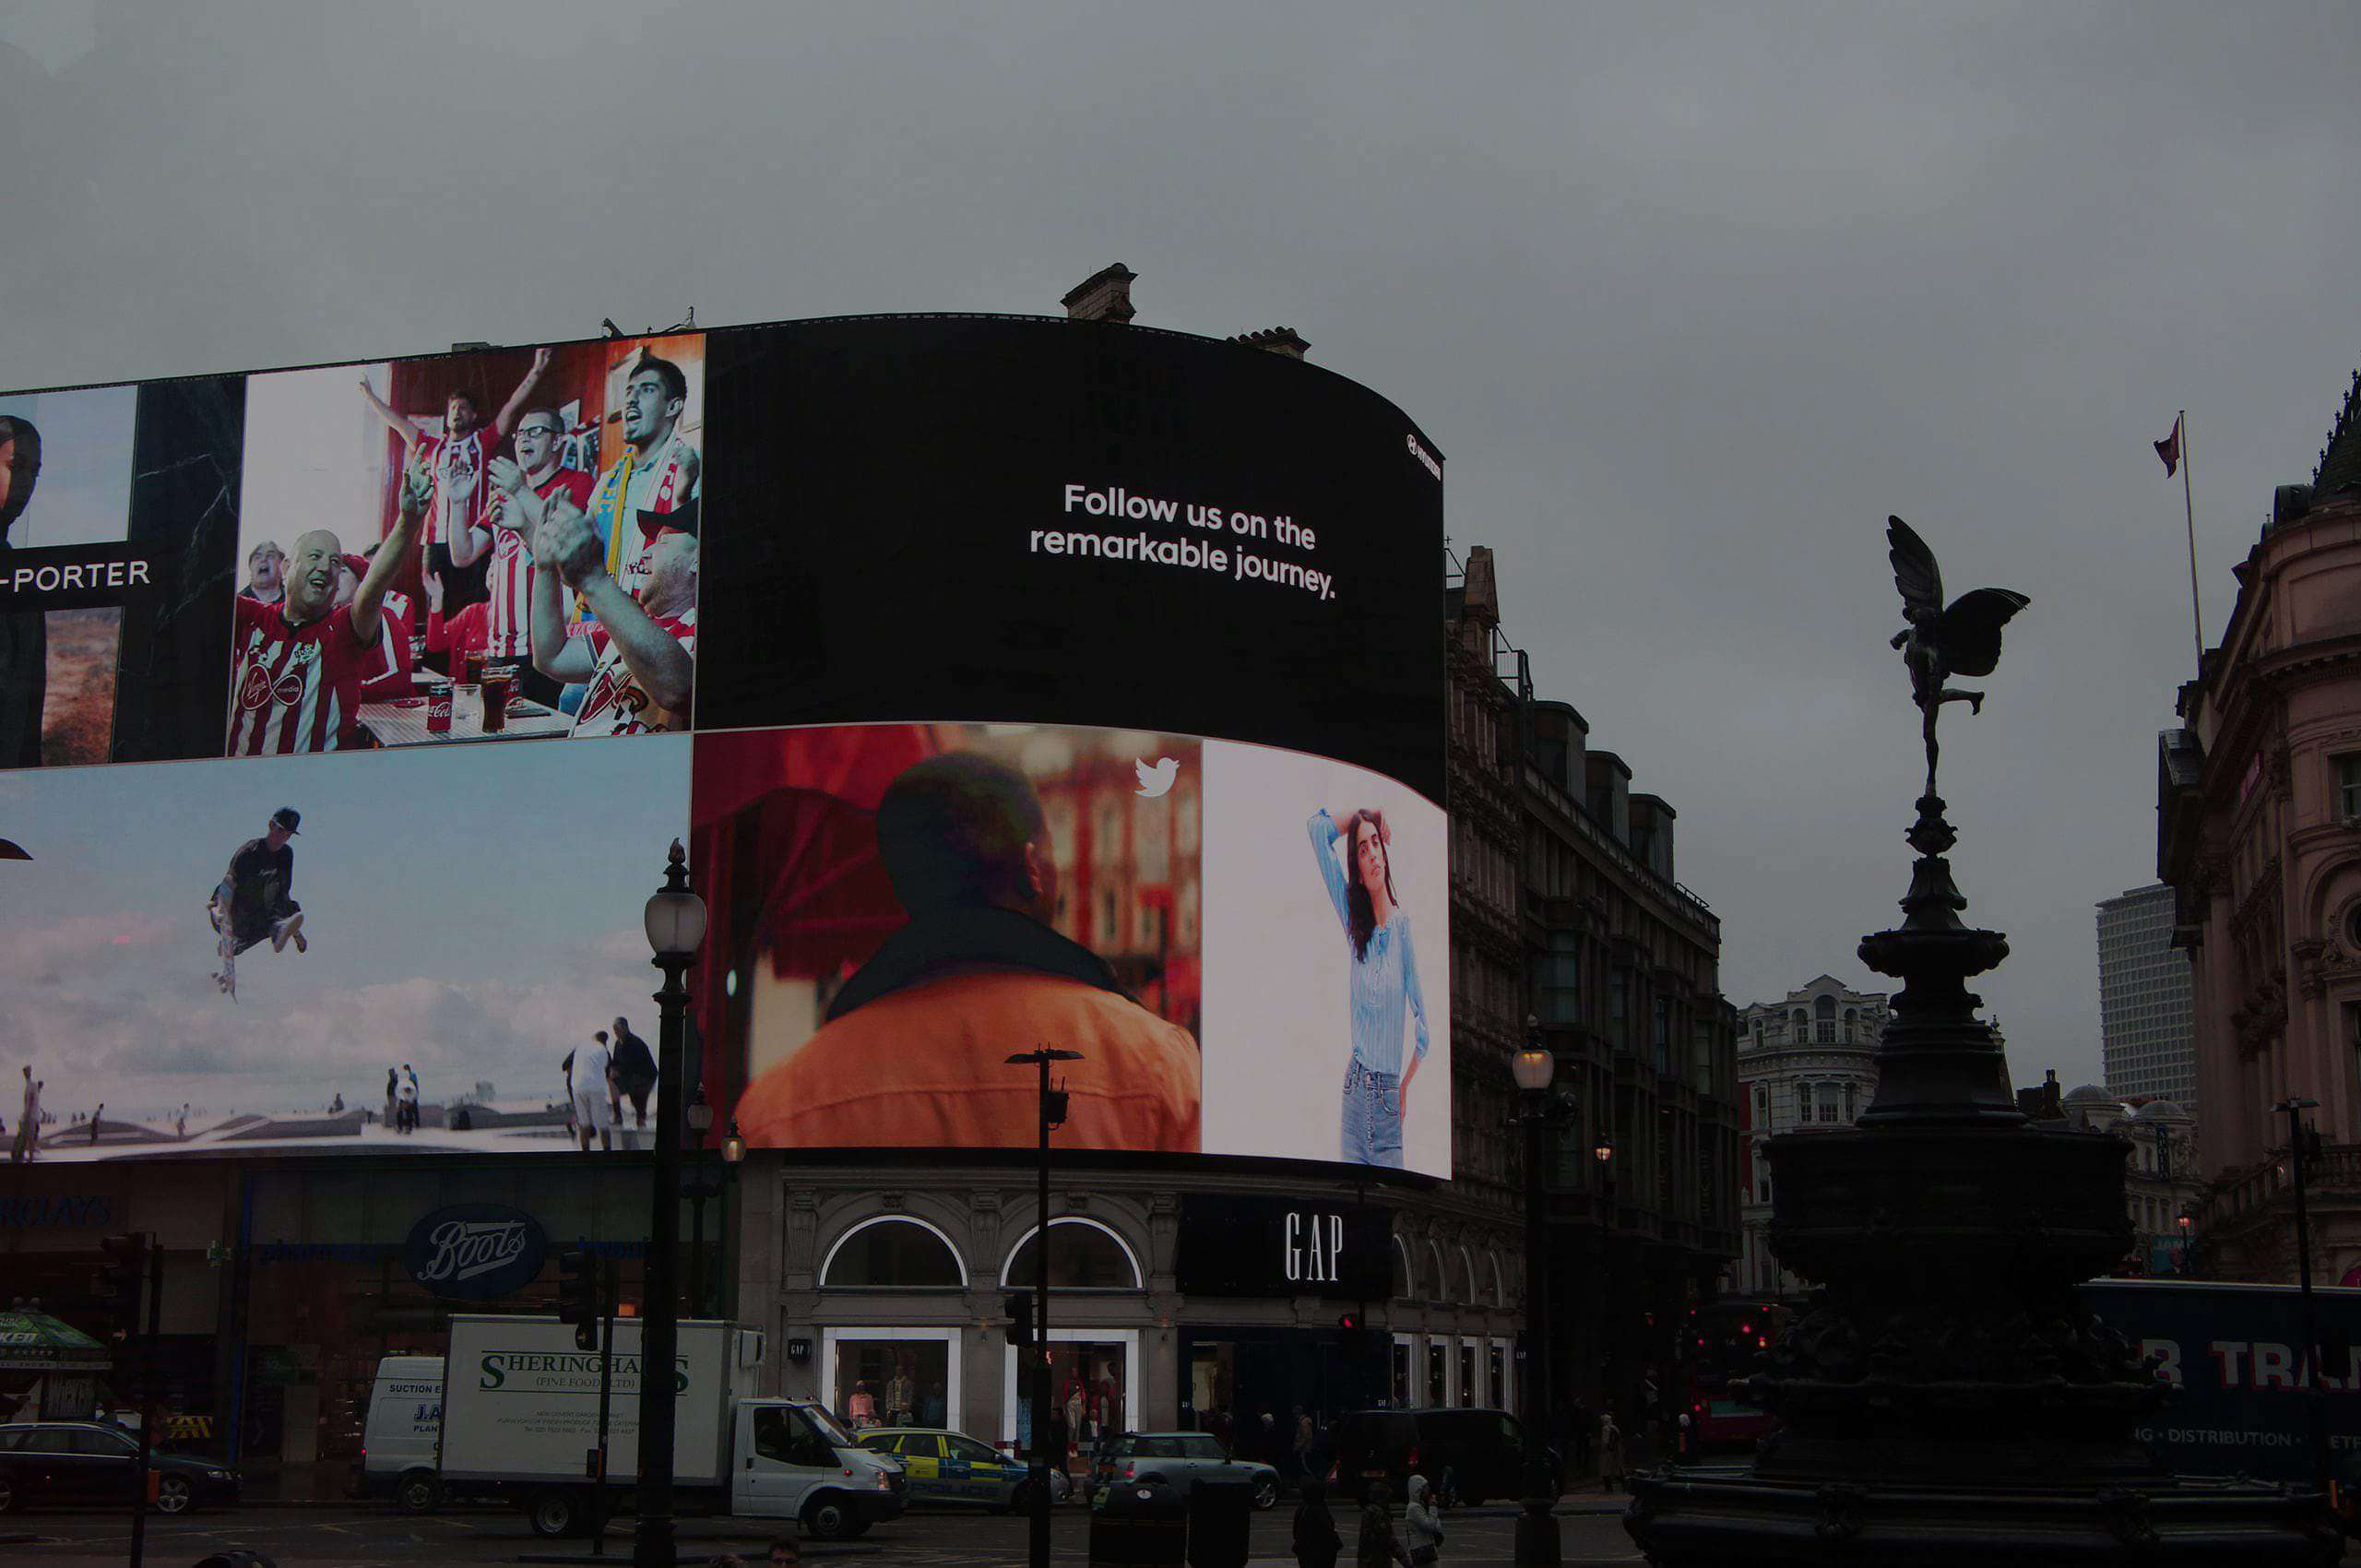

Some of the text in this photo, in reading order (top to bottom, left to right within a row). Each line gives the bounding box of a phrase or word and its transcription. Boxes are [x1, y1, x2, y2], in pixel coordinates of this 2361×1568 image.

[1064, 484, 1316, 551] Follow us on the
[1030, 530, 1335, 600] remarkable journey.
[418, 1219, 528, 1281] Boots
[1285, 1211, 1344, 1282] GAP
[389, 1384, 433, 1394] SUCTION
[2168, 1429, 2293, 1446] DISTRIBUTION
